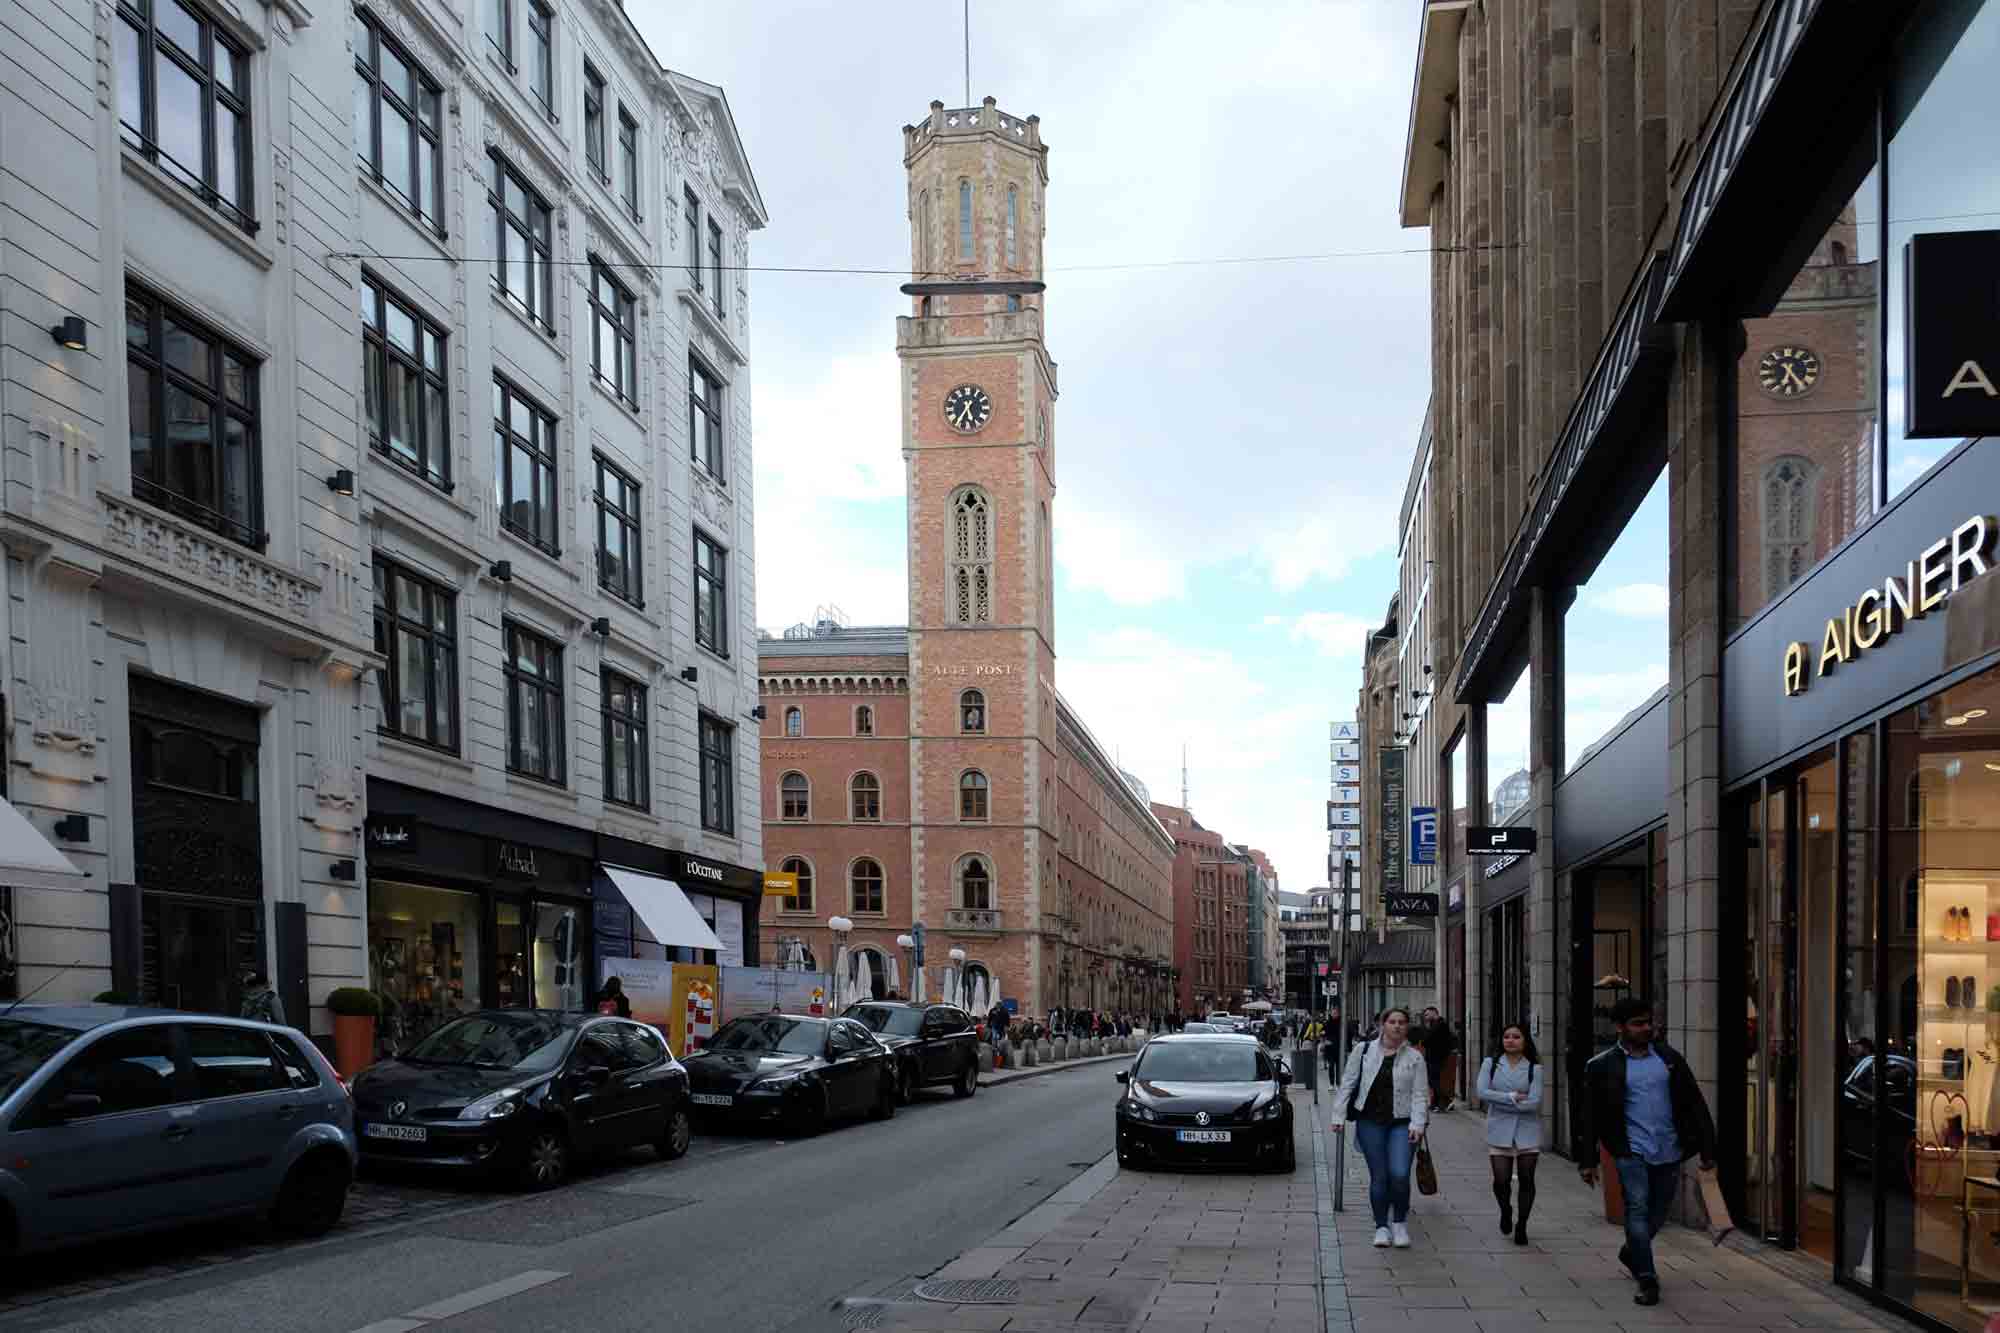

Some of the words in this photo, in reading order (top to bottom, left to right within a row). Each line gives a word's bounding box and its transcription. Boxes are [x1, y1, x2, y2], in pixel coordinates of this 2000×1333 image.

[1817, 515, 1988, 678] AIGNER
[976, 664, 1011, 675] POST
[687, 861, 723, 881] L'OCCITANE
